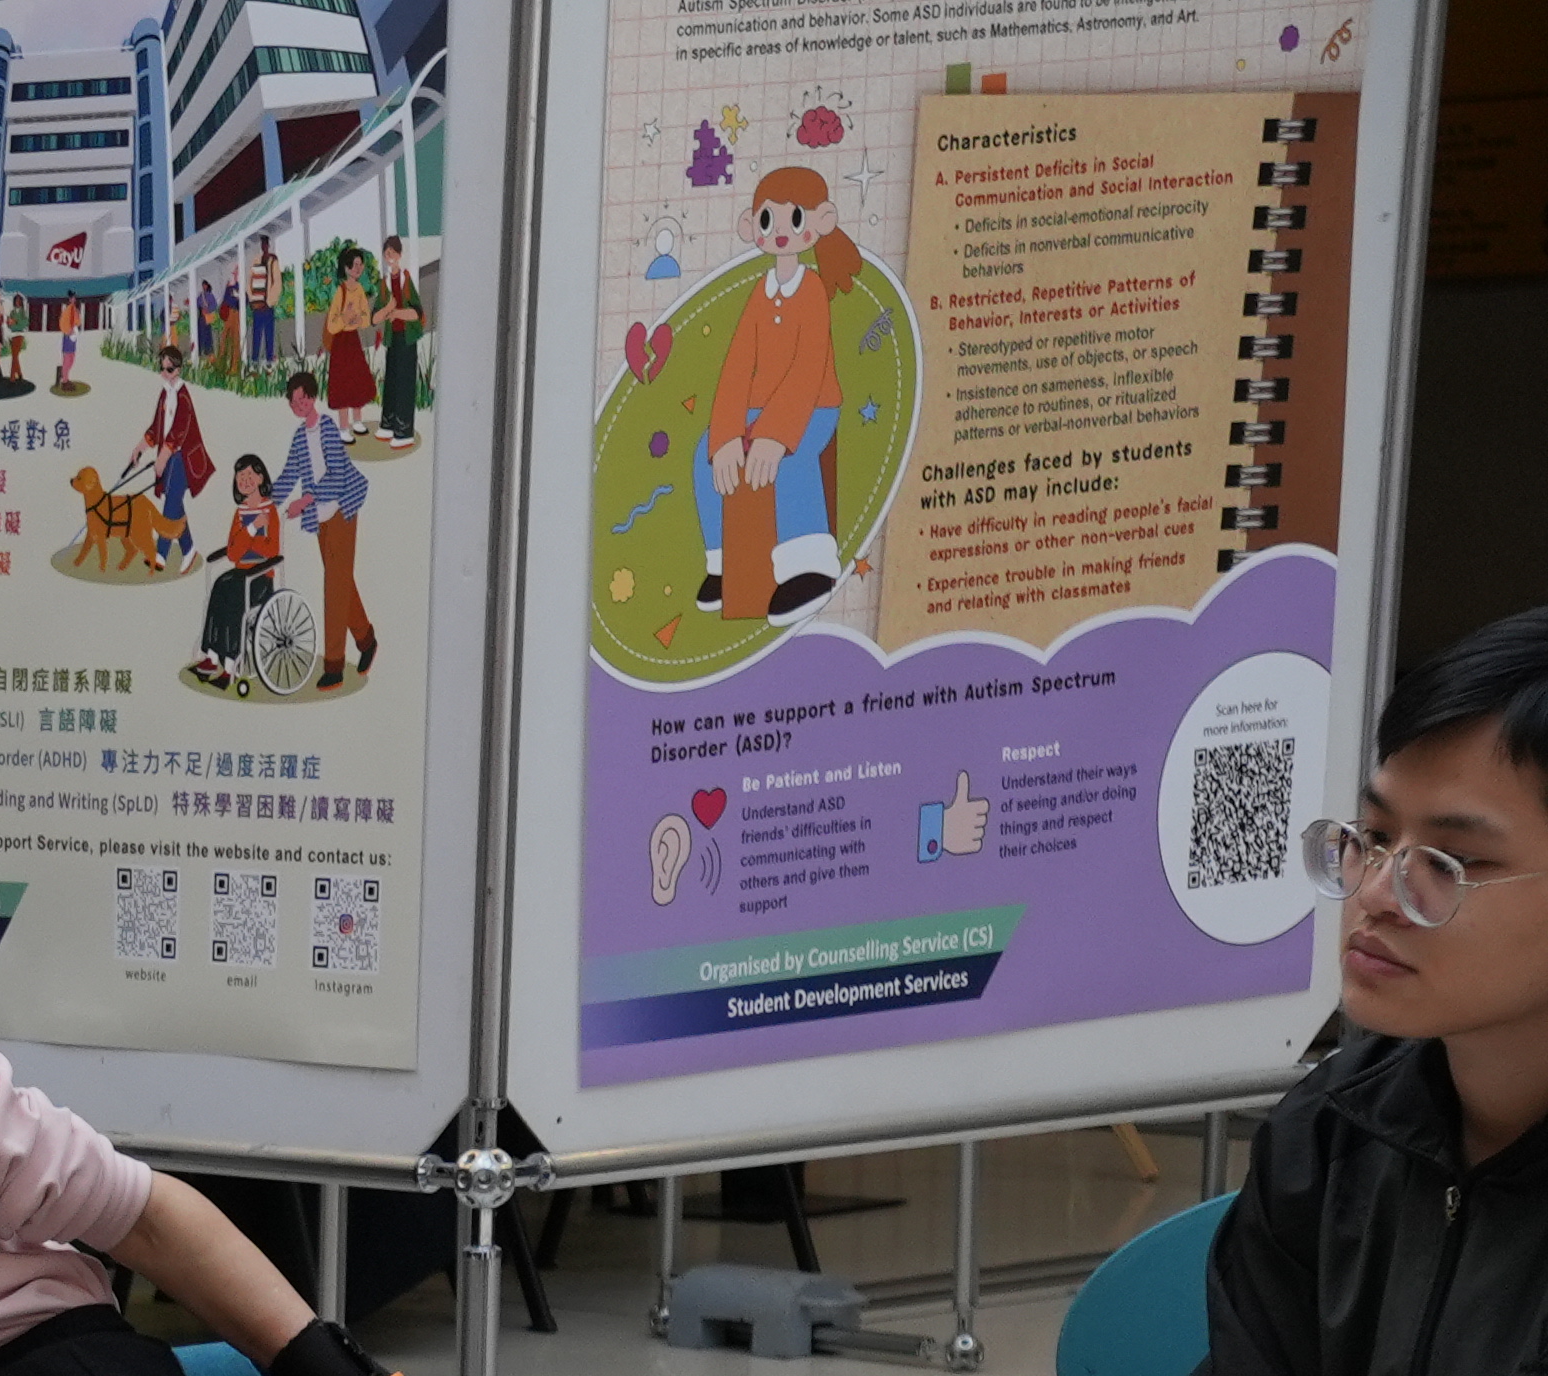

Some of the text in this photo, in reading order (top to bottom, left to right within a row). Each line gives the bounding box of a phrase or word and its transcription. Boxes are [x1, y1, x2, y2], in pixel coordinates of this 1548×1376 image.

[937, 125, 1076, 152] Characteristics
[935, 152, 1154, 186] A. Persistent Deficits in Social
[954, 169, 1233, 208] Communication and Social Interaction
[49, 245, 83, 267] CityU
[922, 440, 1192, 482] Challenges faced by students
[920, 475, 1118, 510] with ASD may include:
[651, 671, 1115, 735] How can we support a friend with Autism Spectrum
[38, 707, 117, 734] 言語障礙
[38, 749, 87, 771] (ADHD)
[651, 730, 792, 763] Disorder (ASD)?
[1002, 740, 1060, 762] Respect
[742, 761, 901, 792] Be Patient and Listen
[28, 791, 54, 808] and
[58, 792, 108, 816] Writing
[112, 793, 158, 816] (SpLD)
[36, 834, 93, 855] Service,
[99, 838, 145, 857] please
[150, 840, 180, 857] visit
[186, 841, 208, 858] the
[213, 843, 270, 861] website
[274, 846, 302, 862] and
[307, 849, 363, 865] contact
[369, 853, 391, 866] us:
[699, 923, 993, 985] Organised by Counselling Service (CS)
[125, 967, 166, 982] website
[226, 975, 257, 987] email
[314, 979, 373, 996] Instagram
[727, 969, 968, 1018] Student Development Services
